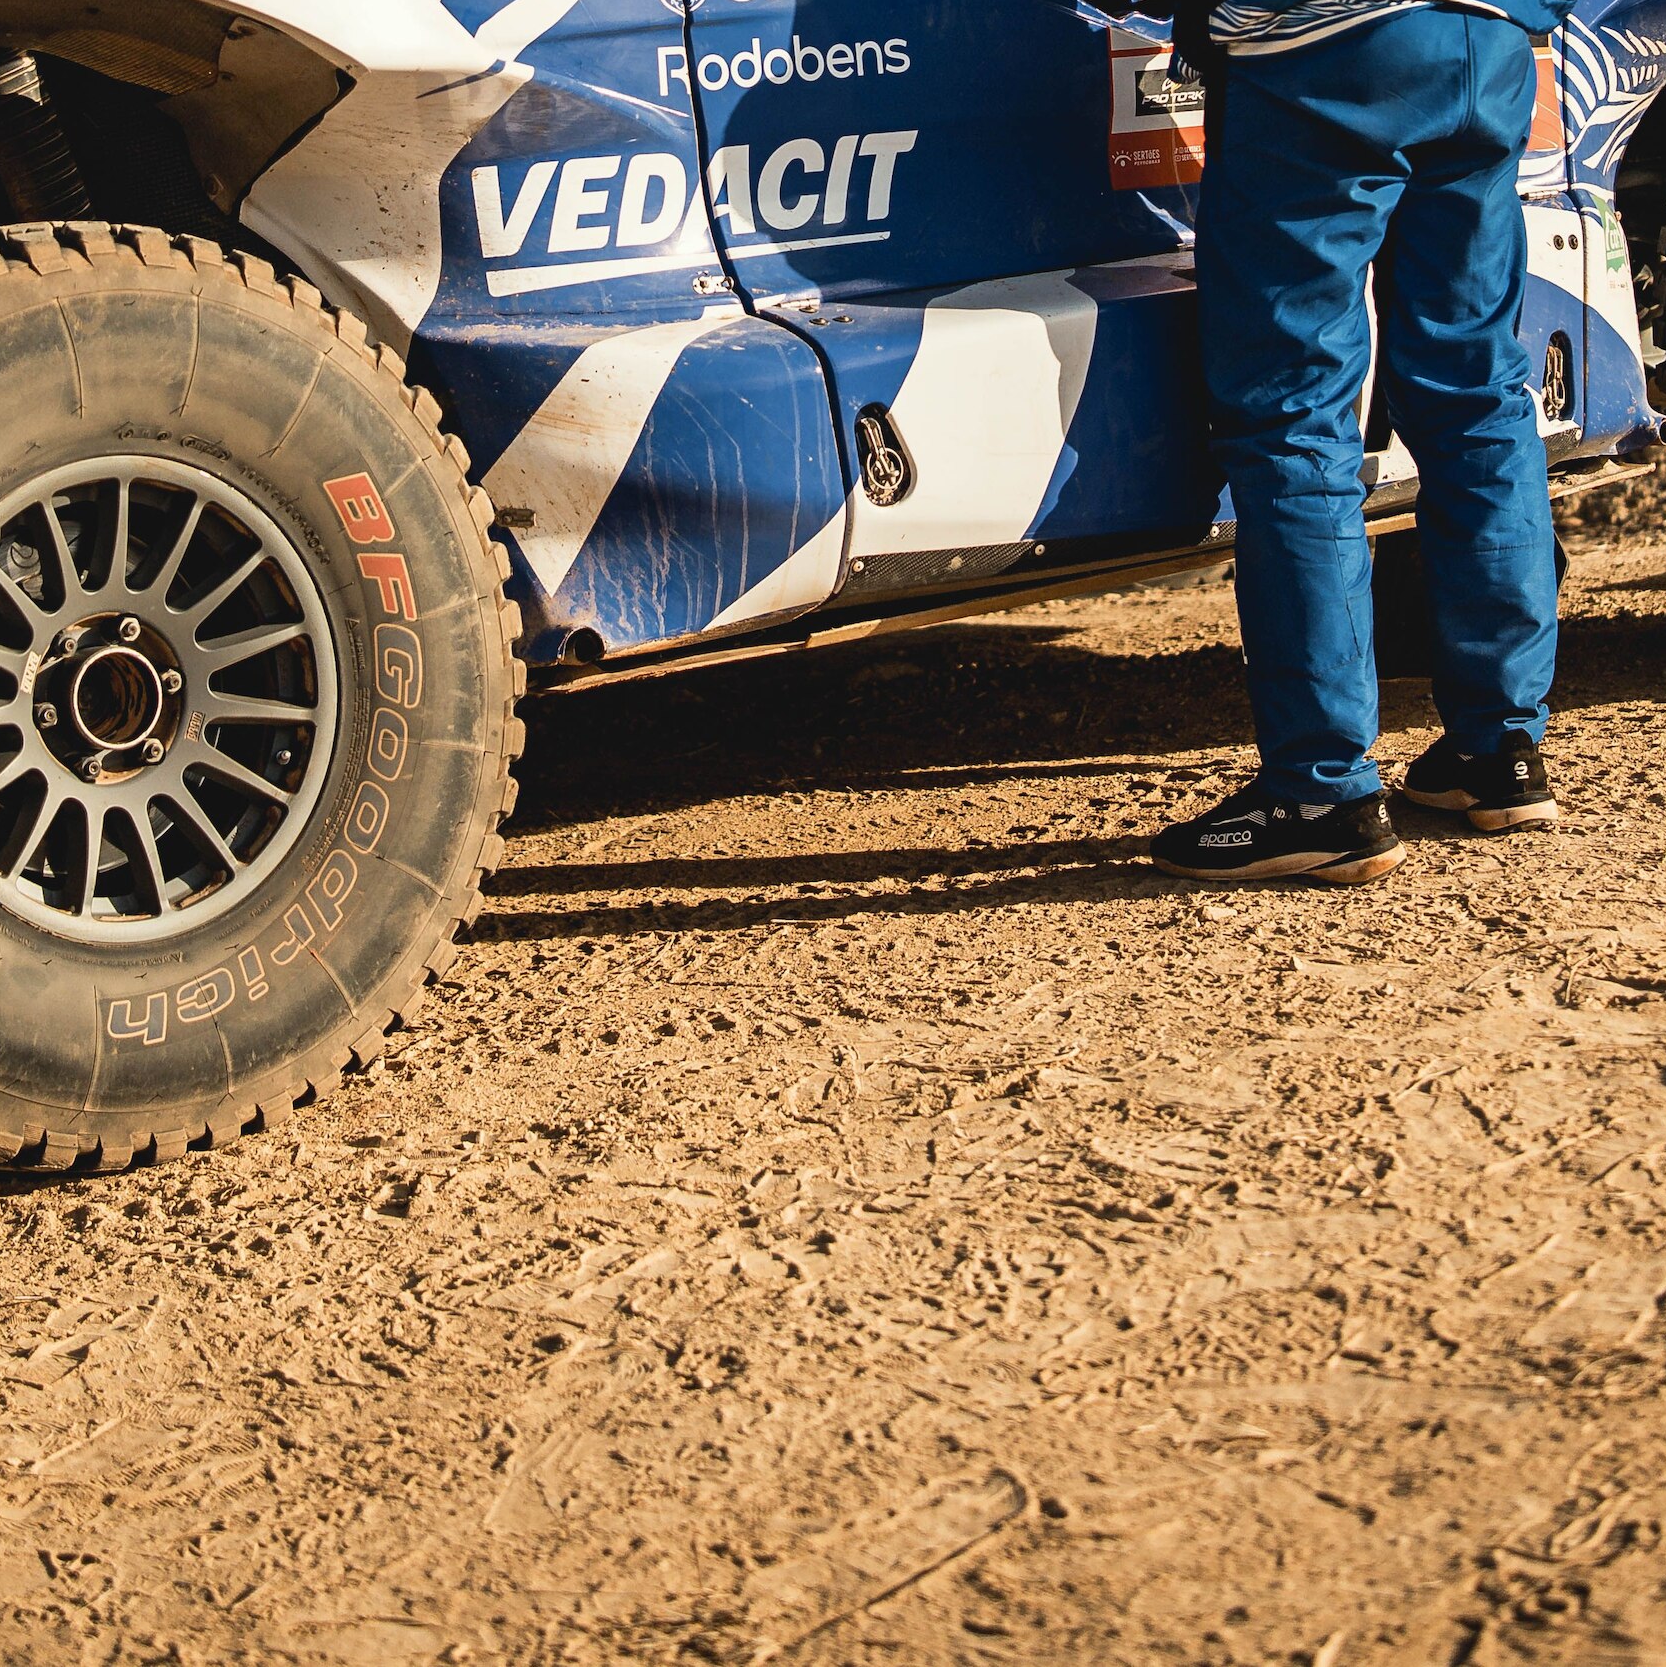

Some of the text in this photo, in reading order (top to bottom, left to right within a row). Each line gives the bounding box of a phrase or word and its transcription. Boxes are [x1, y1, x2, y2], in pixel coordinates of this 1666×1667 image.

[658, 35, 911, 97] Rodobens
[1142, 94, 1169, 104] PRO
[471, 130, 919, 260] VEDACIT
[108, 471, 422, 1046] BFGoodrich
[1200, 829, 1252, 847] sparco
